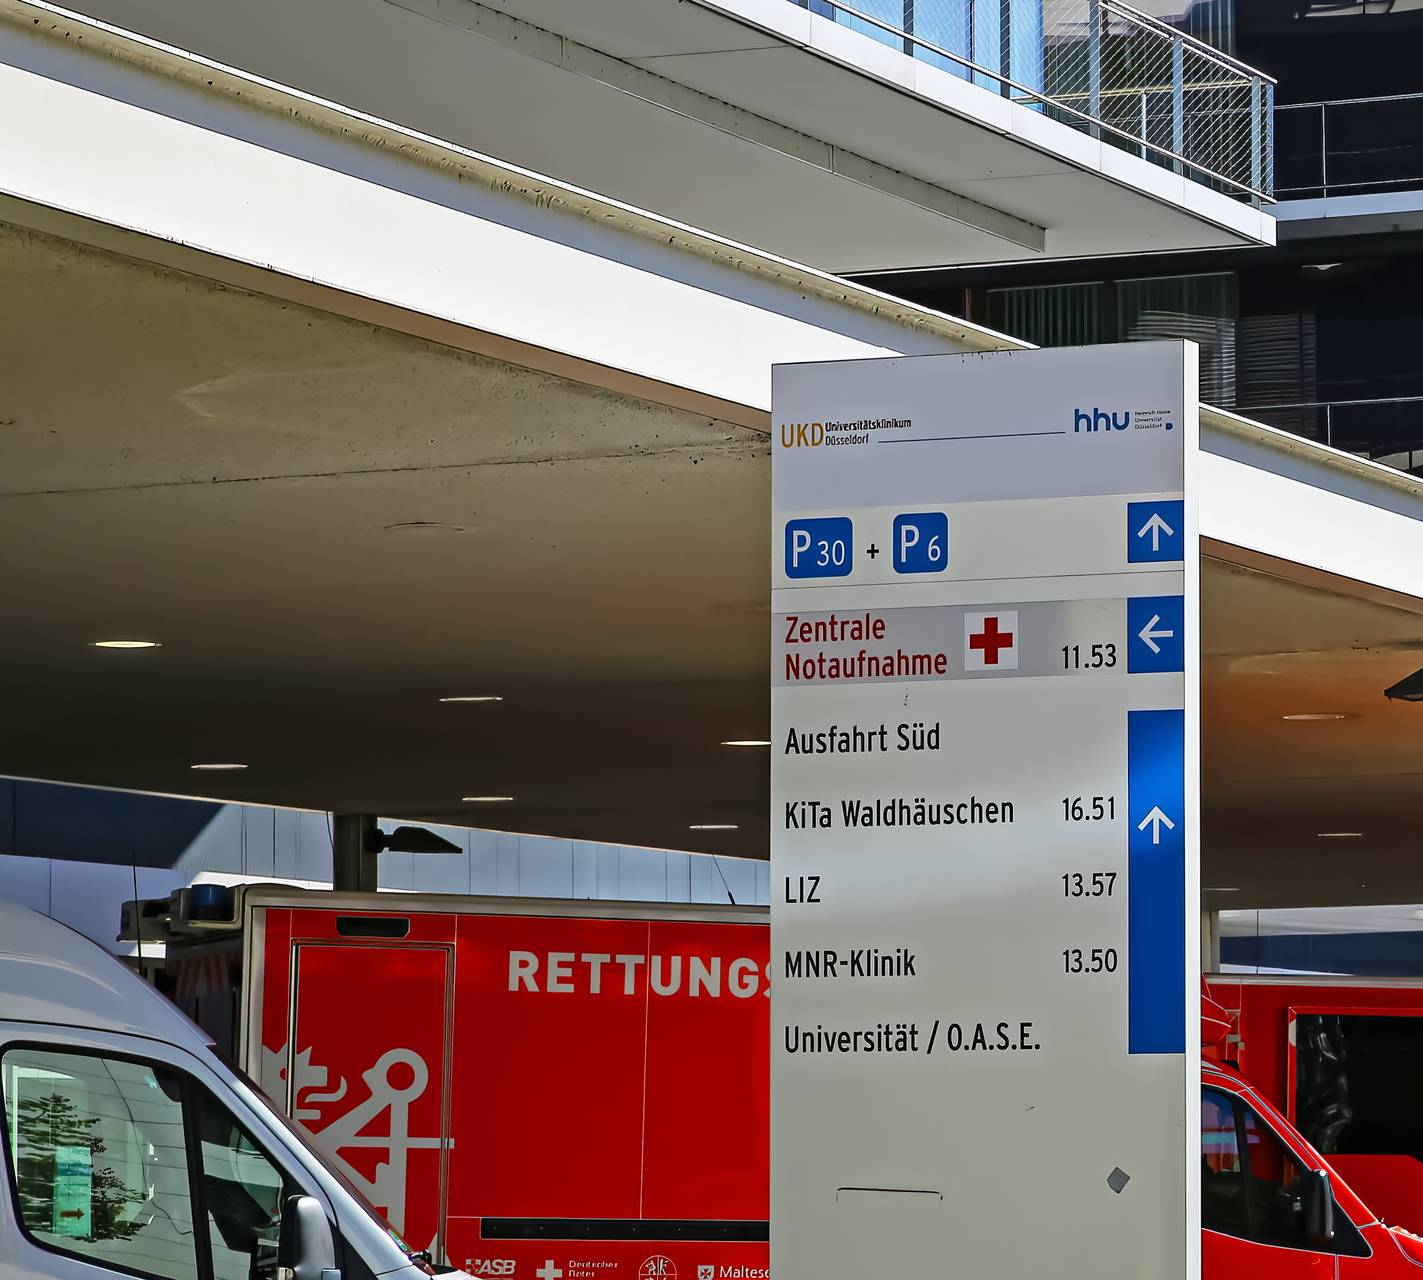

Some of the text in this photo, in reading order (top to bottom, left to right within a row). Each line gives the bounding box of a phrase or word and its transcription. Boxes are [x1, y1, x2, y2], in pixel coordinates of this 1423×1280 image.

[825, 418, 912, 433] Universitätsklinikum
[1074, 407, 1130, 433] hhu
[781, 422, 825, 449] UKD
[825, 433, 869, 446] Düsseldorf
[784, 613, 886, 644] Zentrale
[785, 650, 948, 681] Notaufnahme
[1061, 643, 1118, 671] 11.53
[784, 722, 941, 755] Ausfahrt Süd
[784, 796, 1015, 829] KiTa Waldhäuschen
[1062, 796, 1117, 822] 16.51
[784, 876, 821, 904] LIZ
[1062, 872, 1118, 898] 13.57
[508, 950, 771, 999] RETTUNG
[784, 948, 916, 979] MNR-Klinik
[1062, 948, 1118, 974] 13.50
[784, 1022, 918, 1054] Universität
[947, 1022, 1041, 1052] O.A.S.E.
[477, 1259, 516, 1275] ASB
